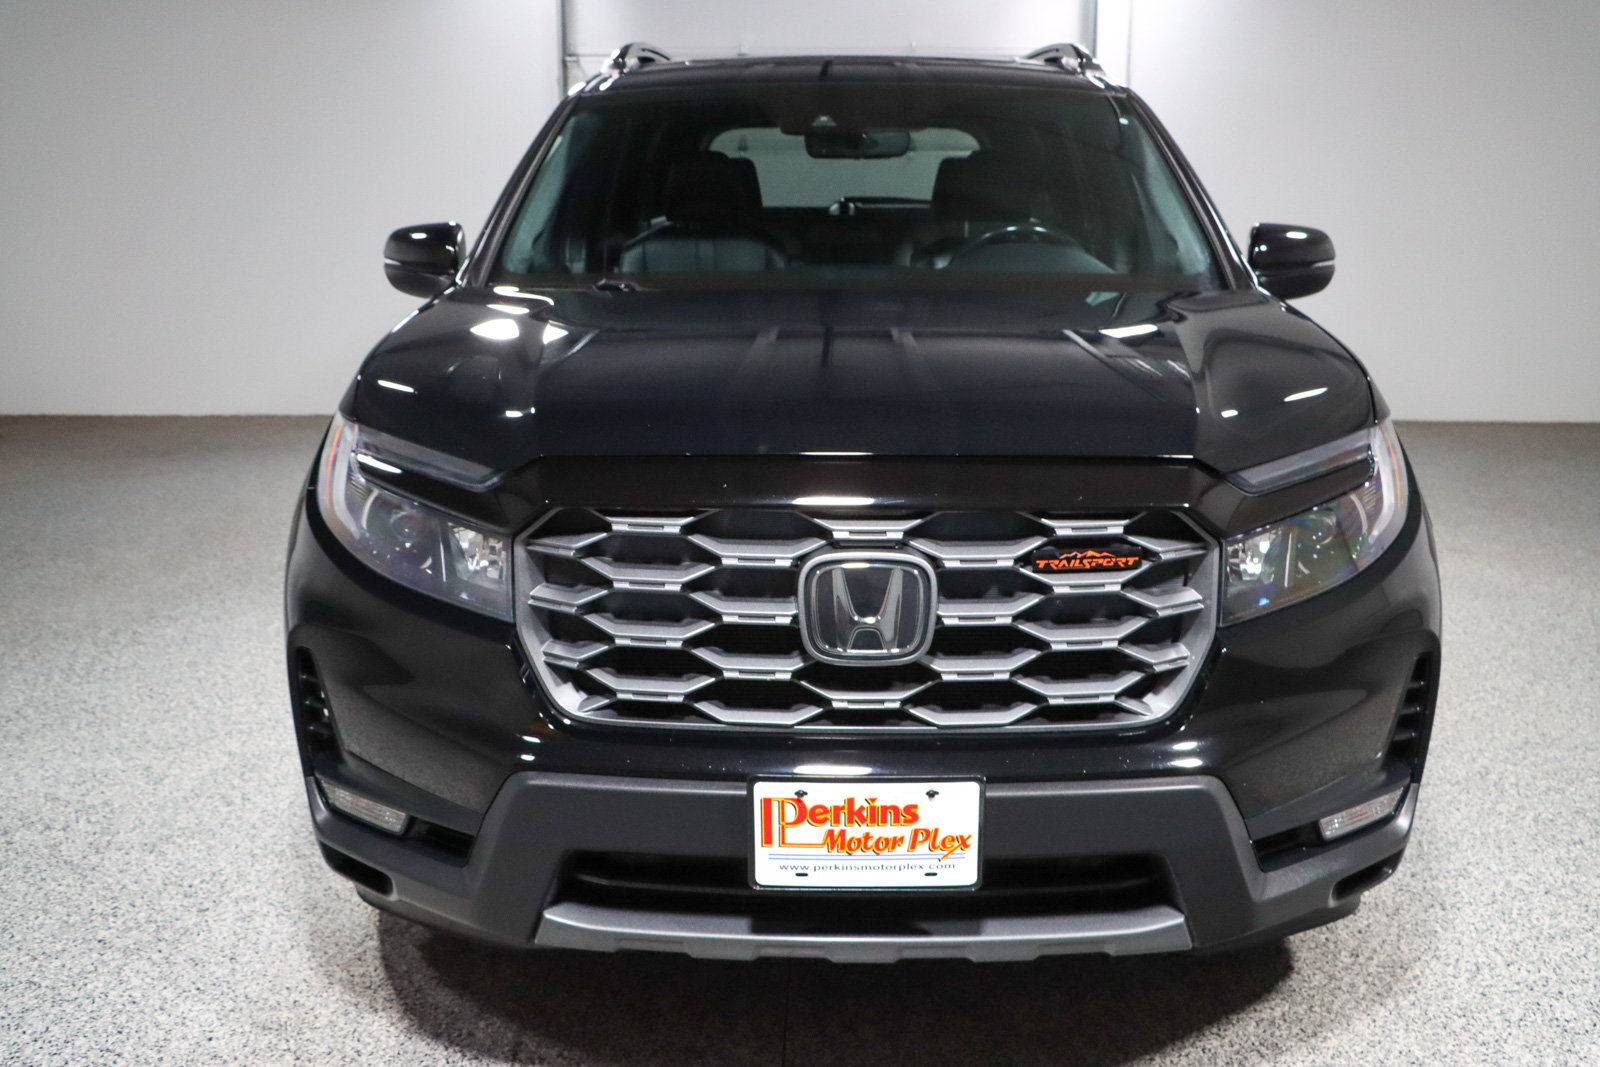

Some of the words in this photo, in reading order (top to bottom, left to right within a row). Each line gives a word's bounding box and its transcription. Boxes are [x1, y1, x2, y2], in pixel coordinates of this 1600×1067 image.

[1036, 557, 1139, 570] TRAILSPORT
[761, 797, 920, 847] Perkins
[823, 828, 905, 855] Motor
[907, 827, 973, 861] Plex
[779, 862, 956, 872] www.perkinsmotorplex.com
